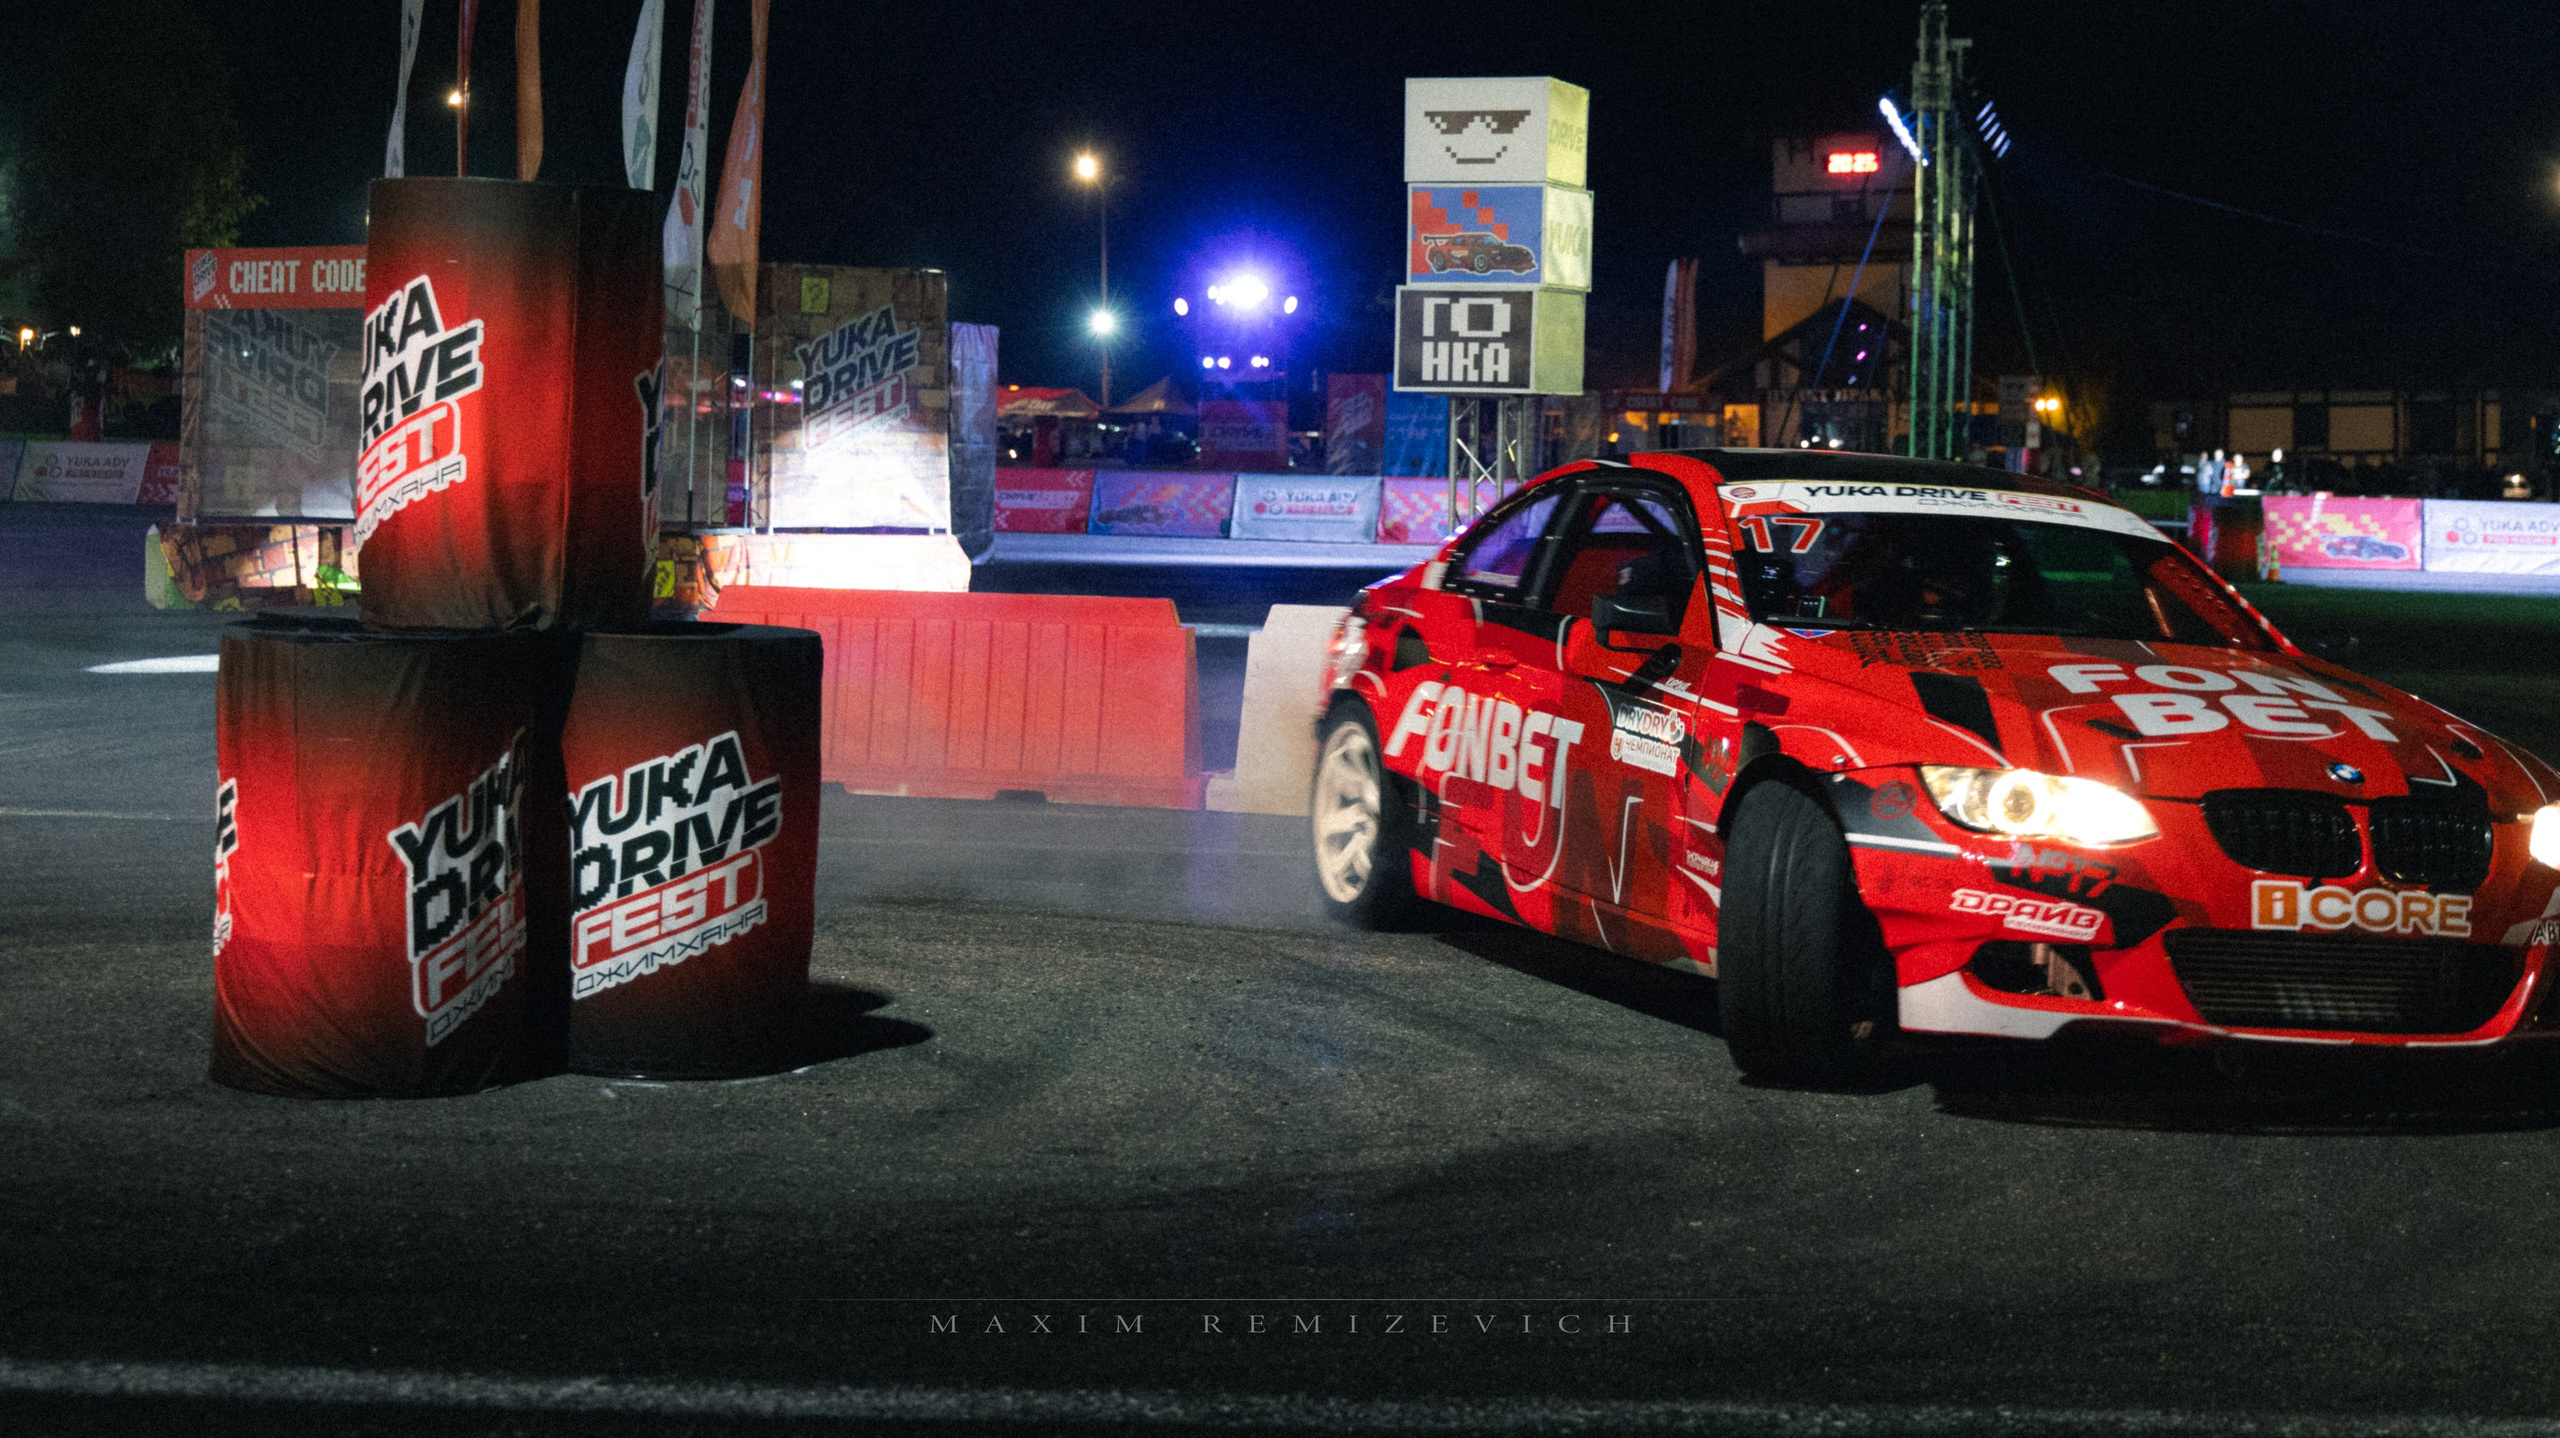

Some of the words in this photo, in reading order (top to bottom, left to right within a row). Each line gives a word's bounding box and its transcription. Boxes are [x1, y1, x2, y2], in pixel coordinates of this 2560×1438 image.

[230, 261, 300, 293] CHEAT
[312, 259, 367, 292] CODE
[362, 281, 440, 382] UKA
[799, 305, 898, 378] YUKA
[1422, 297, 1511, 337] ГО
[803, 329, 918, 418] DRIVE
[1421, 341, 1510, 382] НКА
[362, 326, 479, 452] RIVE
[358, 405, 448, 510] EST
[1804, 485, 1888, 497] YUKA
[1896, 486, 1987, 502] DRIVE
[1739, 517, 1825, 553] 17
[2480, 520, 2523, 532] YUKA
[2047, 664, 2348, 703] FON
[1616, 703, 1669, 740] DRYDRY
[2111, 693, 2400, 743] BET
[1384, 680, 1585, 810] FONBET
[1625, 740, 1679, 763] ЧЕМПИОНАТ
[568, 737, 746, 851] YUKA
[573, 780, 780, 912] DRIVE
[577, 853, 753, 966] FEST
